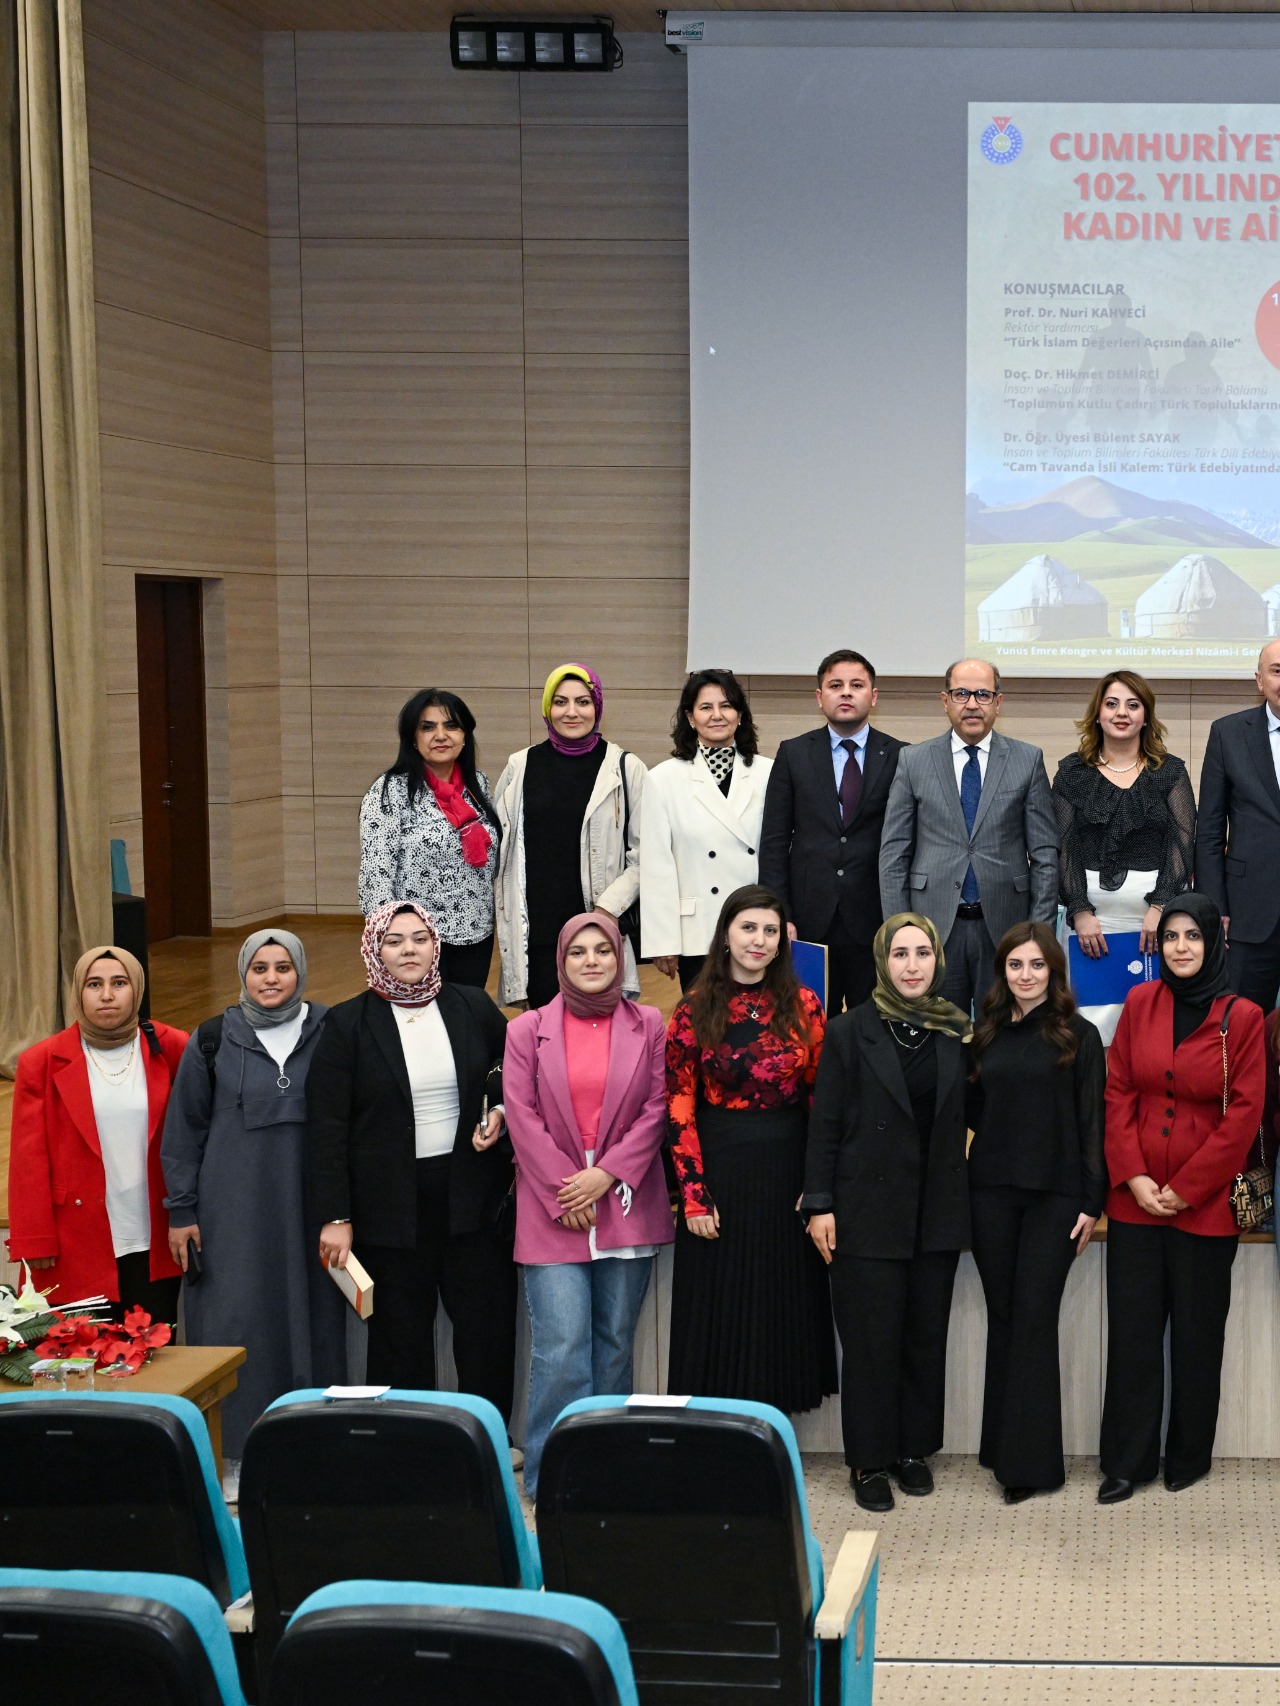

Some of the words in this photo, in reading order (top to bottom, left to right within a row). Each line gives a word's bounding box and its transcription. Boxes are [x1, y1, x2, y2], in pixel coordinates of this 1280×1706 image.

[1072, 172, 1146, 201] 102.
[1063, 212, 1181, 241] KADIN
[1003, 283, 1125, 298] KONUŞMACILAR
[1004, 307, 1034, 318] Prof.
[1038, 308, 1056, 318] Dr.
[1060, 307, 1088, 318] Nuri
[1092, 305, 1146, 319] KAHVECİ
[1043, 335, 1078, 348] İslam
[1082, 337, 1140, 351] Değerleri
[1143, 337, 1206, 351] Açısından
[1004, 368, 1031, 382] Doç.
[1034, 369, 1053, 380] Dr.
[1056, 368, 1103, 380] Hikmet
[1107, 367, 1159, 380] DEMİRCİ
[1003, 432, 1022, 443] Dr.
[1025, 430, 1051, 446] Öğr.
[1055, 430, 1090, 446] Üyesi
[1094, 432, 1135, 443] Bülent
[1139, 432, 1180, 443] SAYAK
[1041, 462, 1095, 473] Tavanda
[1099, 460, 1117, 473] İsli
[1121, 462, 1164, 473] Kalem:
[1167, 461, 1197, 473] Türk
[996, 647, 1028, 656] Yunus
[1030, 648, 1058, 656] Emre
[1060, 648, 1098, 658] Kongre
[1115, 647, 1149, 656] Kültür
[1151, 647, 1193, 656] Merkezi
[1242, 647, 1261, 657] Gen
